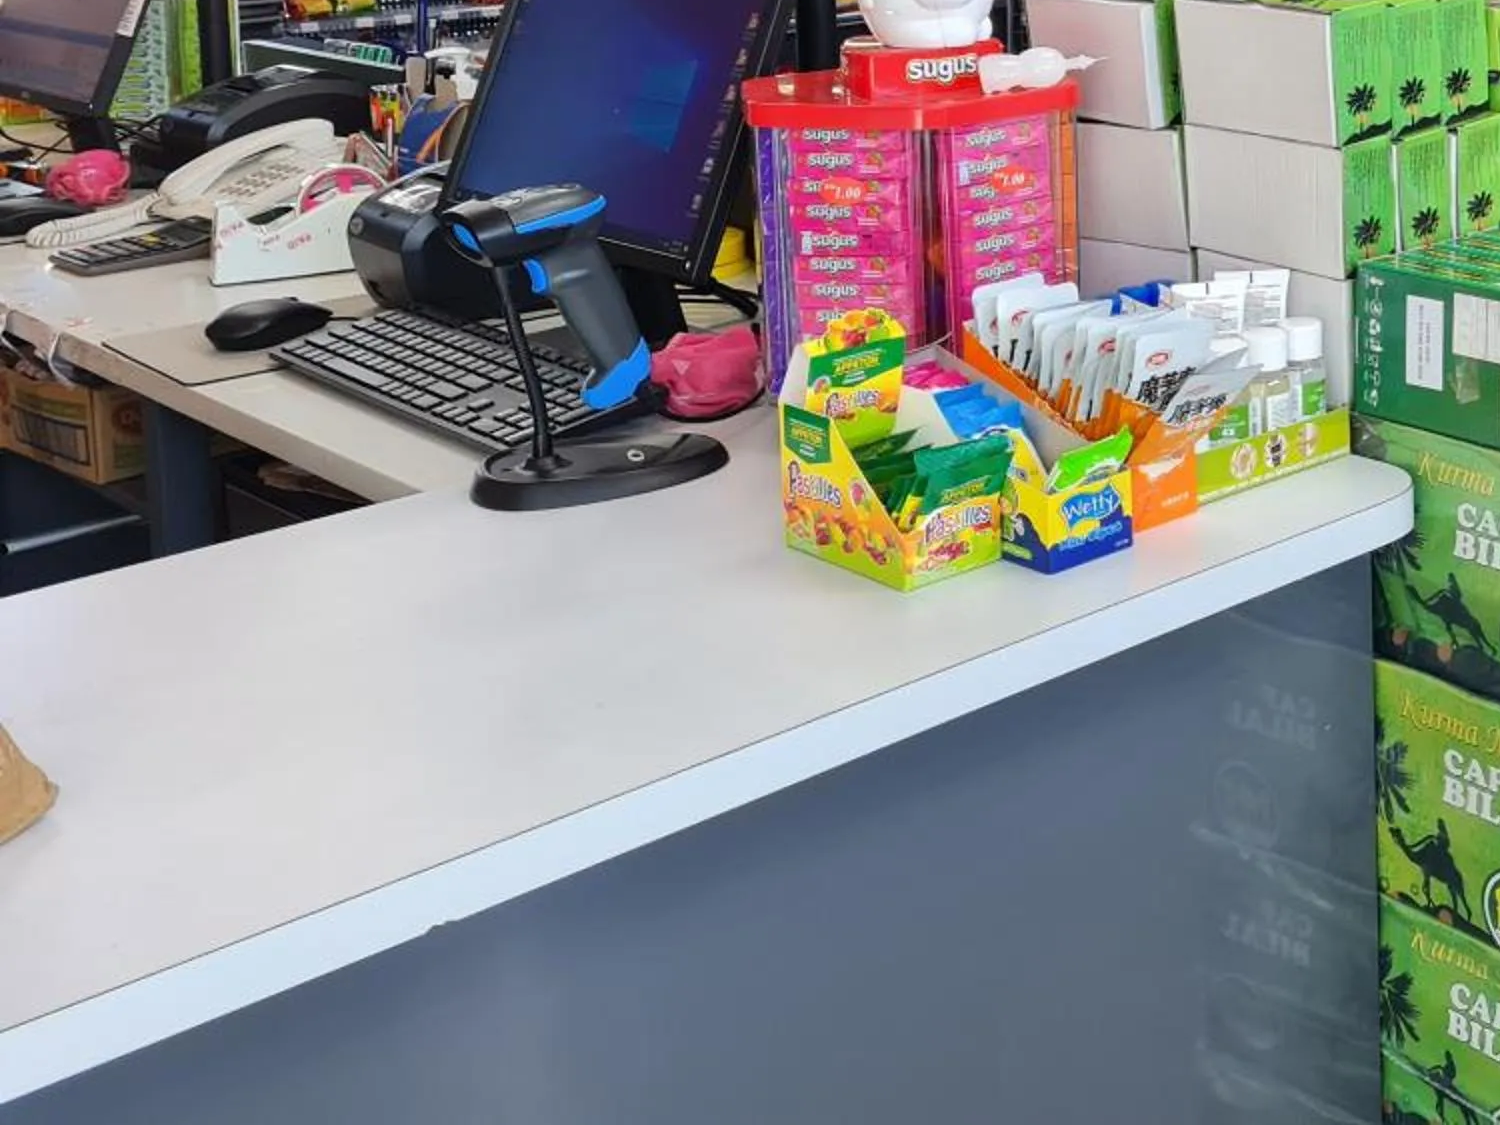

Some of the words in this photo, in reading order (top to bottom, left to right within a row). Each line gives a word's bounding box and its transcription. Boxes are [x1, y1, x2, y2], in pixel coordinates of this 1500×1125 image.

[906, 54, 978, 84] sugus
[803, 128, 849, 144] sugus
[967, 129, 1007, 147] sugus
[808, 153, 853, 169] sugus
[968, 155, 1008, 173] sugus
[806, 204, 852, 220] sugus
[975, 207, 1014, 227] sugus
[812, 235, 858, 251] sugus
[975, 234, 1015, 253] sugus
[810, 257, 856, 274] sugus
[975, 260, 1017, 280] sugus
[814, 284, 860, 299] sugus
[1418, 450, 1495, 498] Kurma
[1063, 492, 1115, 520] Wetty
[1400, 691, 1479, 745] Kurma
[1411, 927, 1488, 980] Kurma
